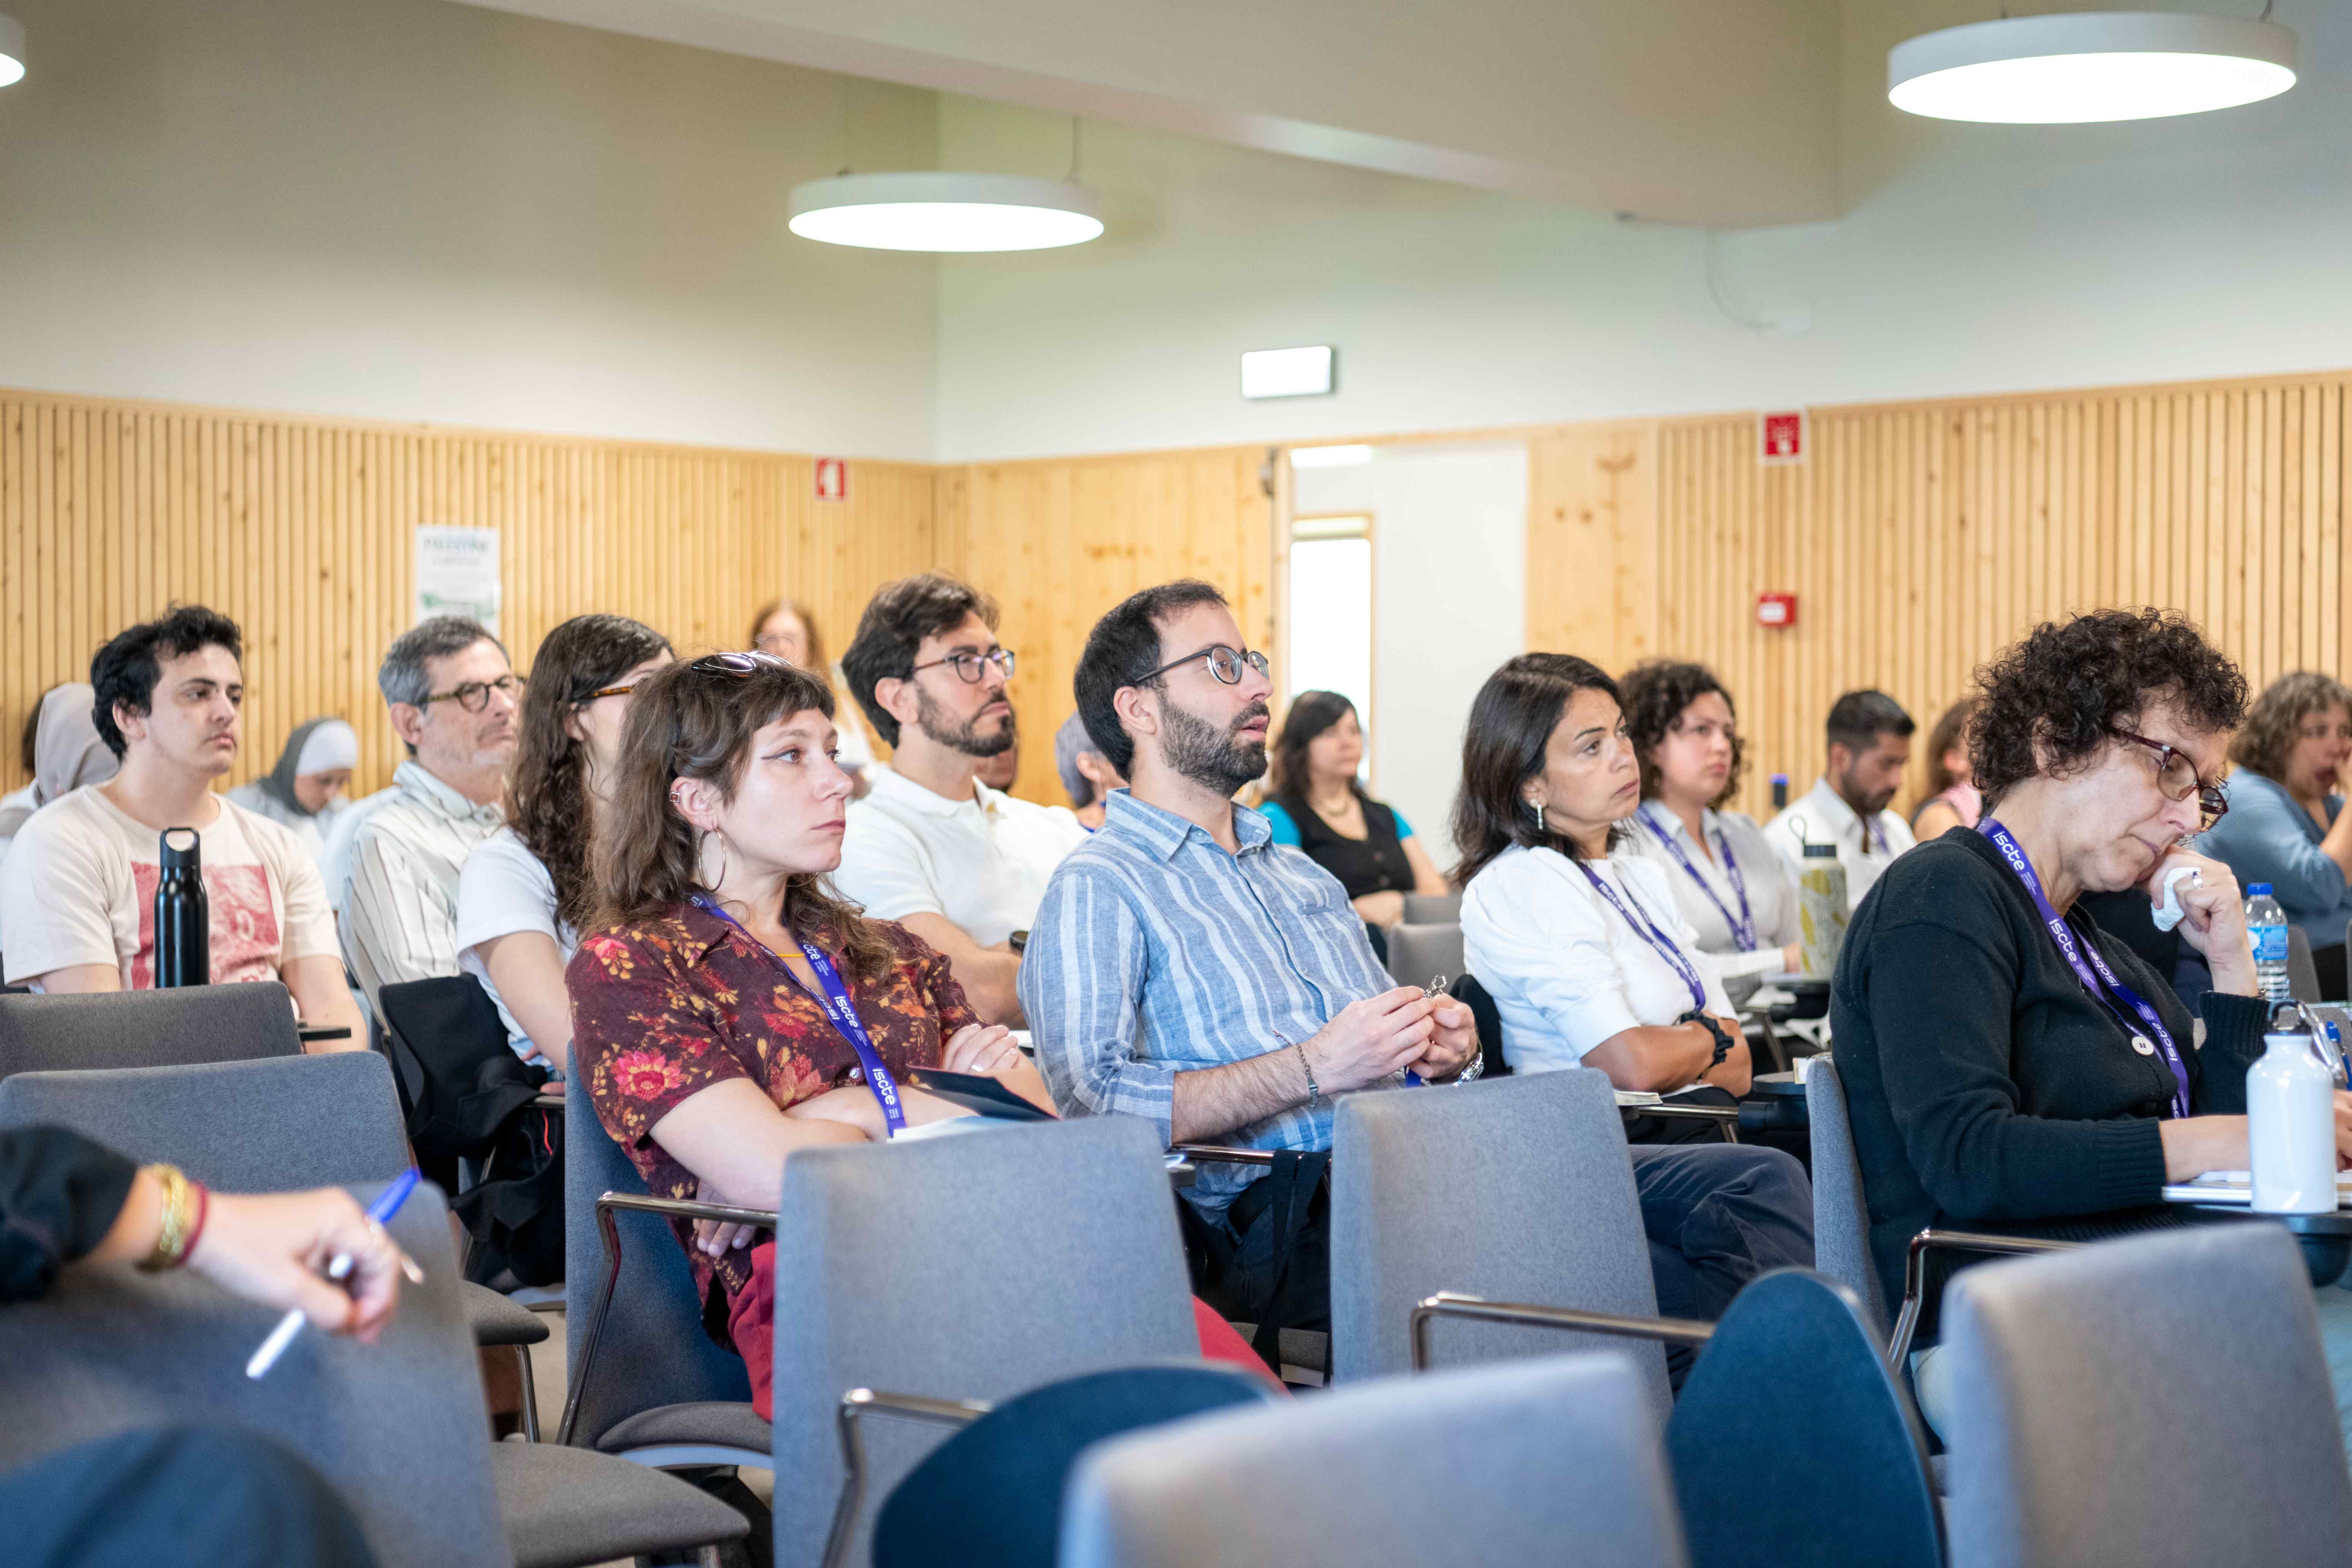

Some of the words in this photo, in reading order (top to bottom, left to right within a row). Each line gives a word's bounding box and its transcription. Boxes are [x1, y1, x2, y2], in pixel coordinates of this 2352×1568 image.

[1993, 831, 2025, 870] iscte
[1598, 882, 1624, 911] iscte
[2049, 918, 2077, 962] iscte
[2091, 952, 2120, 986] iscte
[815, 993, 840, 1020] isct
[834, 996, 858, 1027] iscte
[2152, 1023, 2178, 1061] iscte
[872, 1069, 895, 1105] iscte
